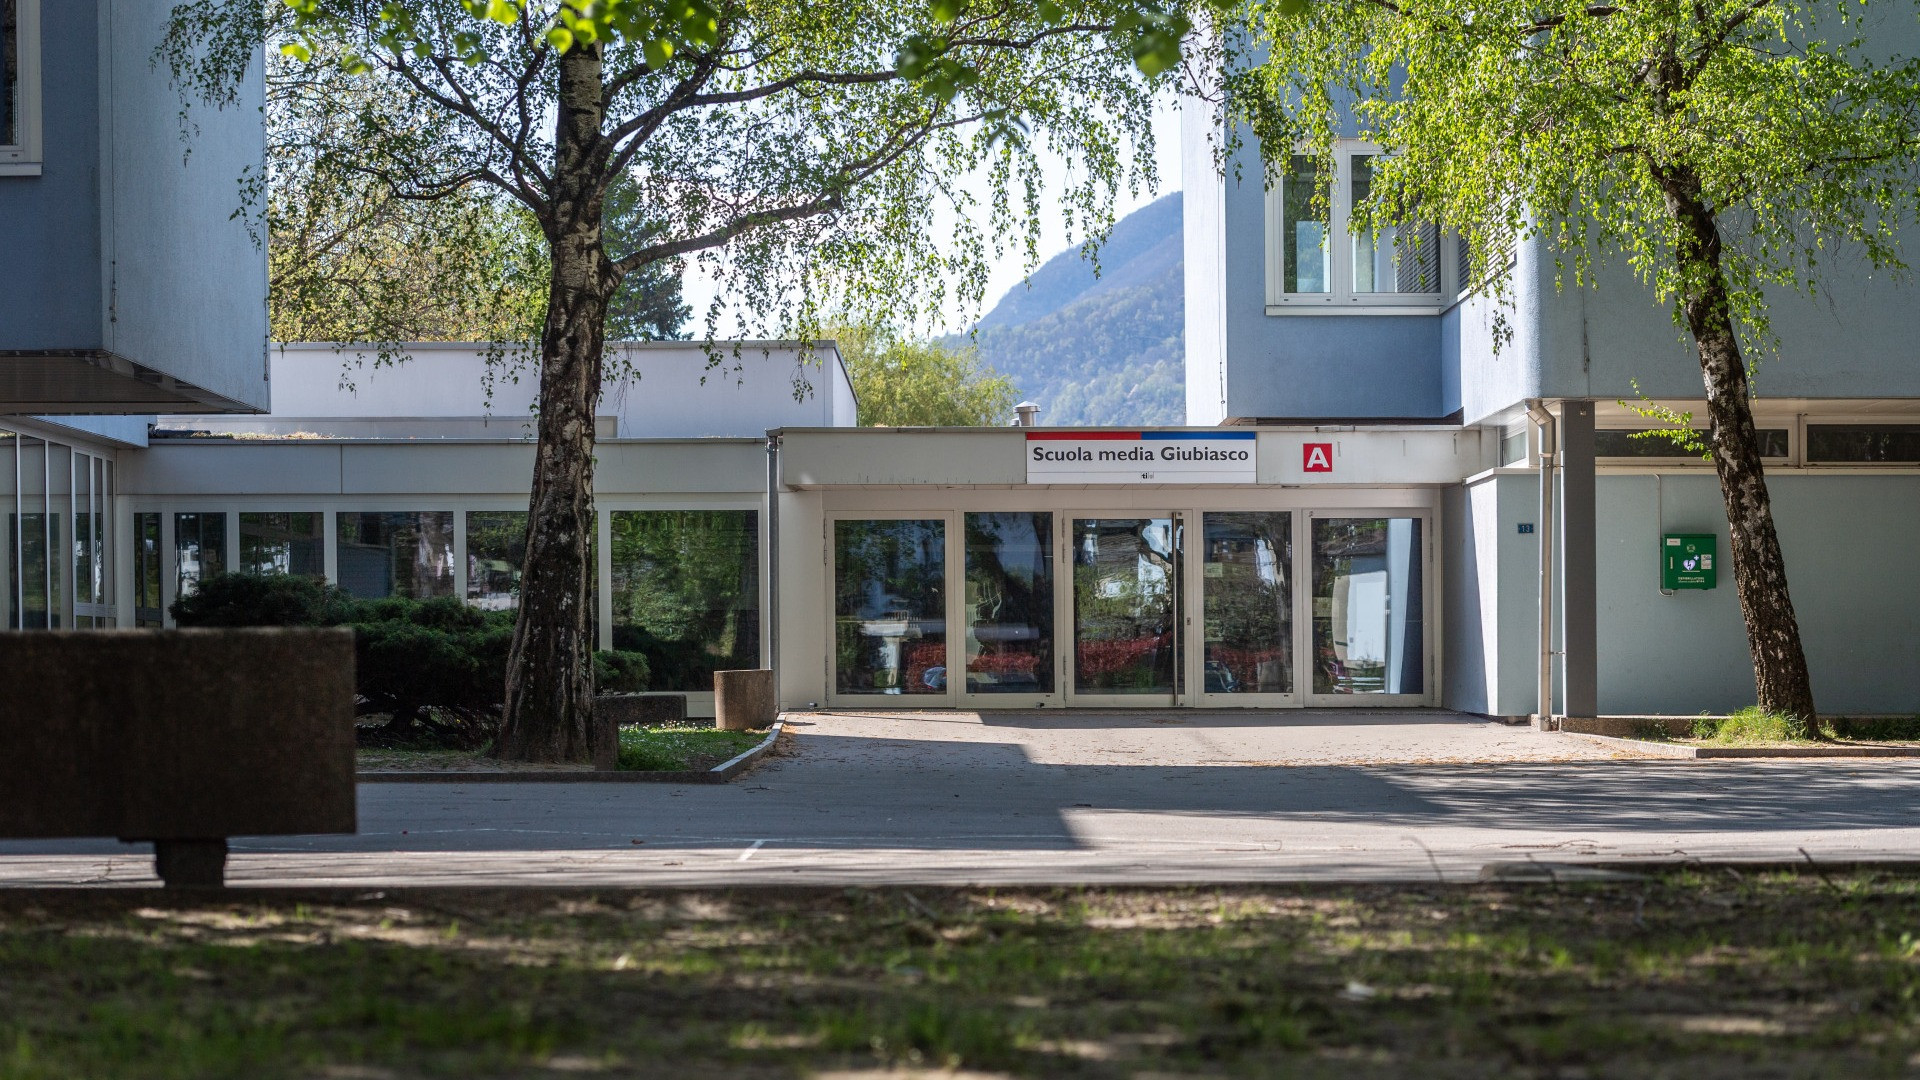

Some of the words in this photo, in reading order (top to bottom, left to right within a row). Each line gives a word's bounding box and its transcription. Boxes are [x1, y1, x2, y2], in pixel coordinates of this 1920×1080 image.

[1033, 446, 1093, 462] Scuola
[1098, 446, 1155, 461] media
[1160, 446, 1249, 461] Giubiasco
[1306, 447, 1330, 468] A
[1521, 524, 1531, 533] 13
